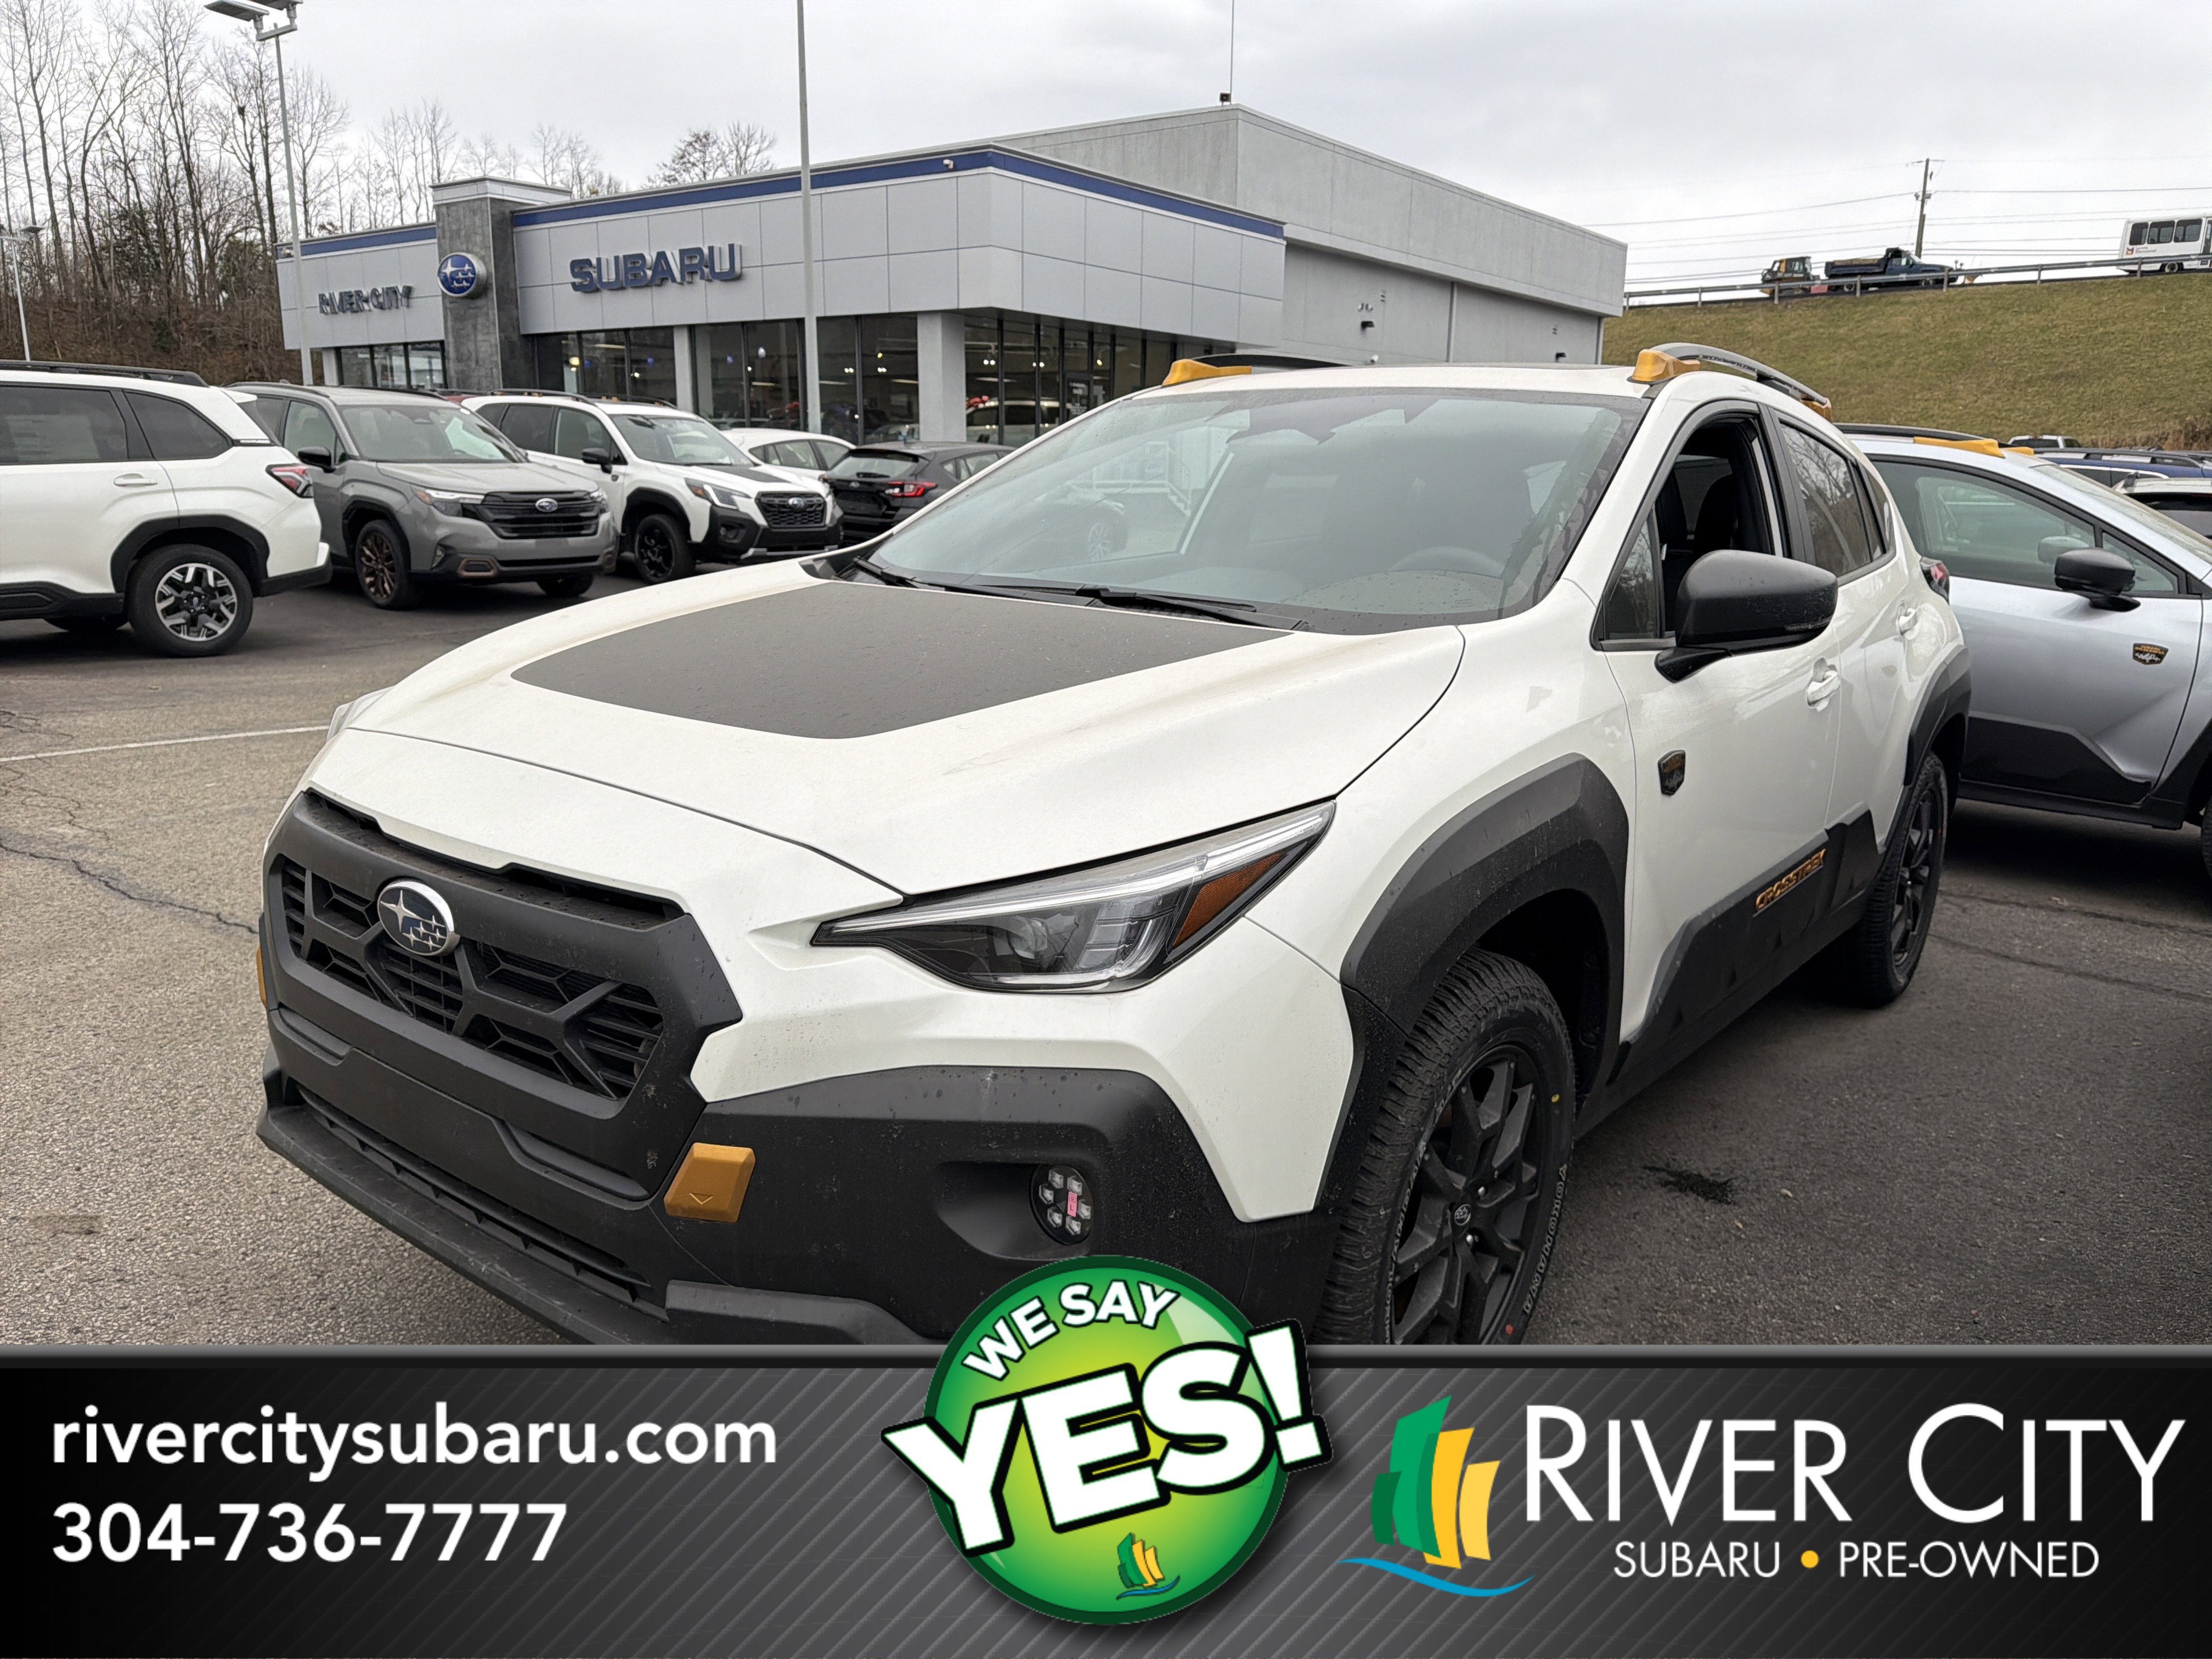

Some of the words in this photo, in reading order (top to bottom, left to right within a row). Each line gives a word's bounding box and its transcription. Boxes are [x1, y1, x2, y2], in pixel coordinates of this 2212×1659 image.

[570, 244, 742, 292] SUBARU
[370, 285, 413, 310] CITY
[1756, 849, 1826, 911] CROSSTREK
[1522, 1164, 1567, 1314] YOKOHAMA
